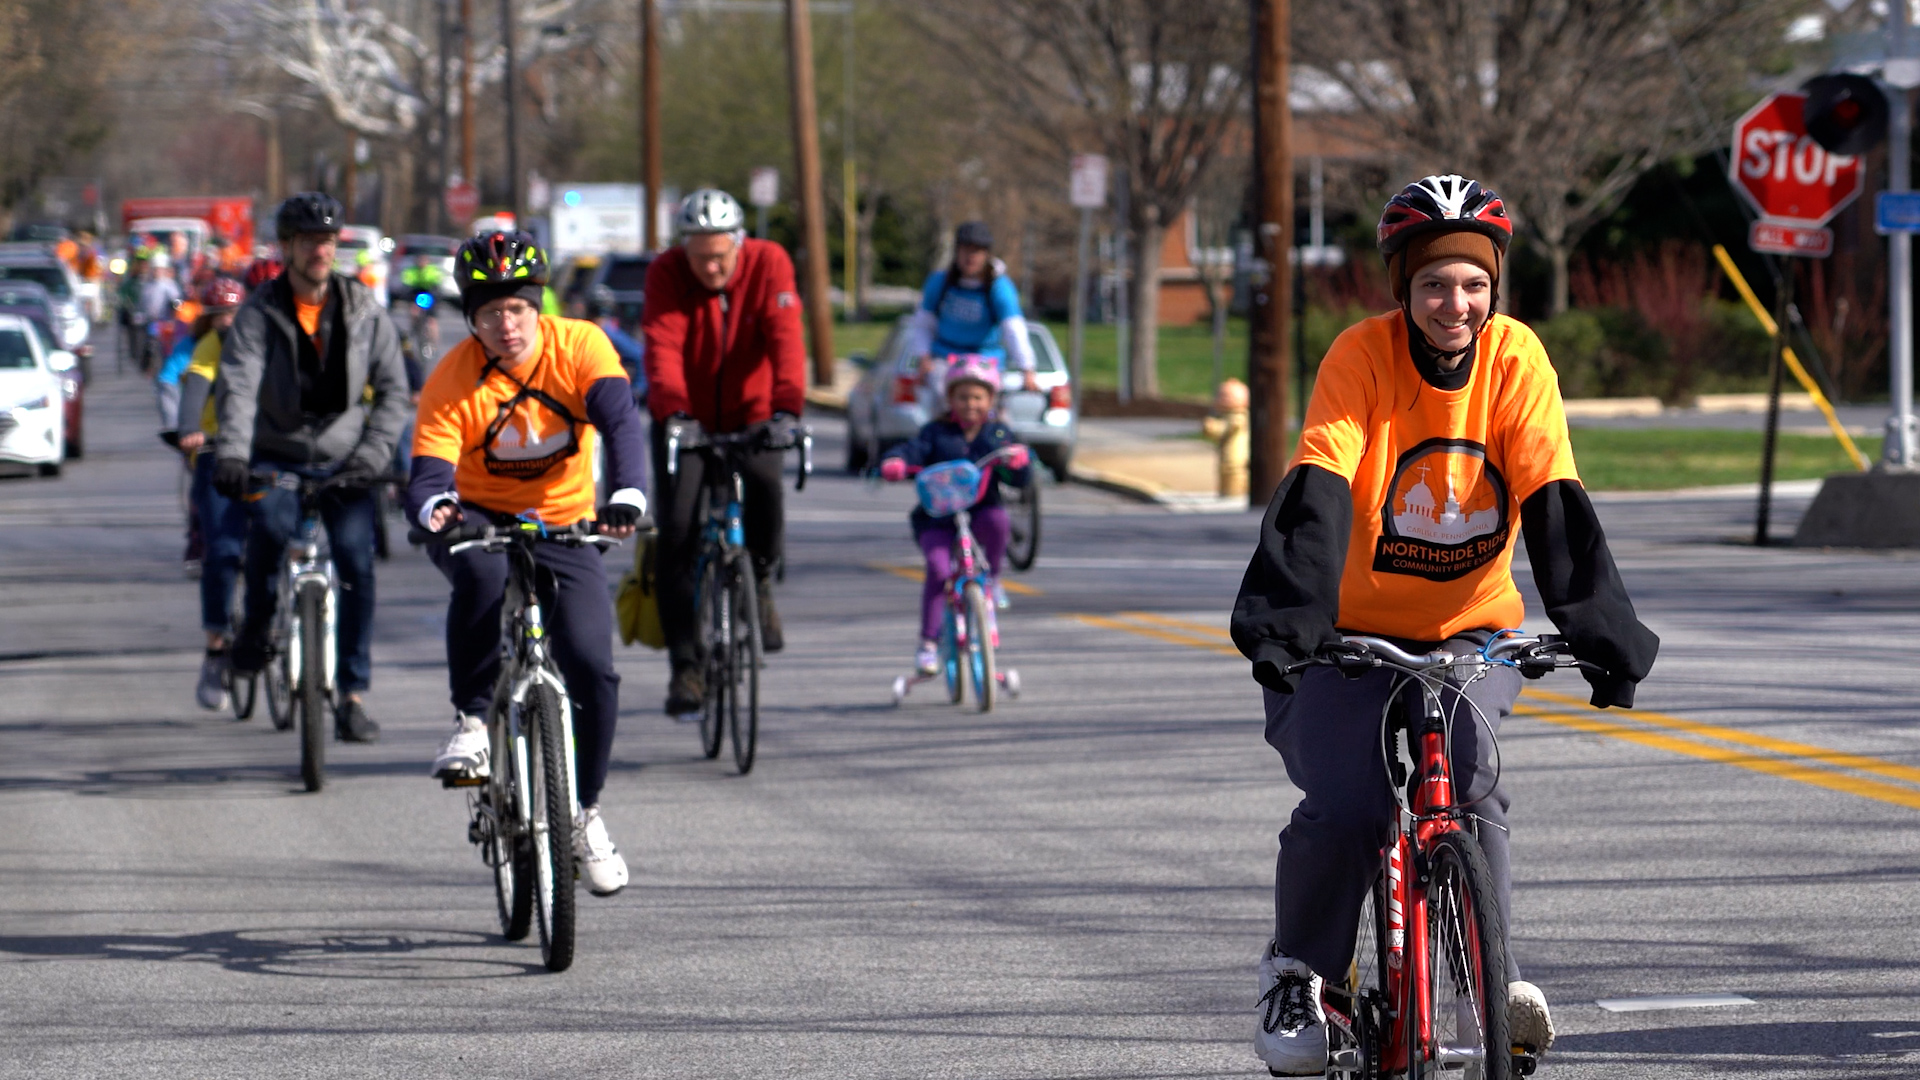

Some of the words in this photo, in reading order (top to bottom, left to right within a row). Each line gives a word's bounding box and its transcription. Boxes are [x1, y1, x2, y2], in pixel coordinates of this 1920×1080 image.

[1743, 128, 1856, 186] STOP
[1441, 523, 1489, 539] PENNSYLVANIA
[1382, 542, 1475, 562] NORTHSIDE
[1477, 529, 1507, 554] RIDE
[1393, 559, 1452, 573] COMMUNITY
[1453, 560, 1472, 572] BIKE
